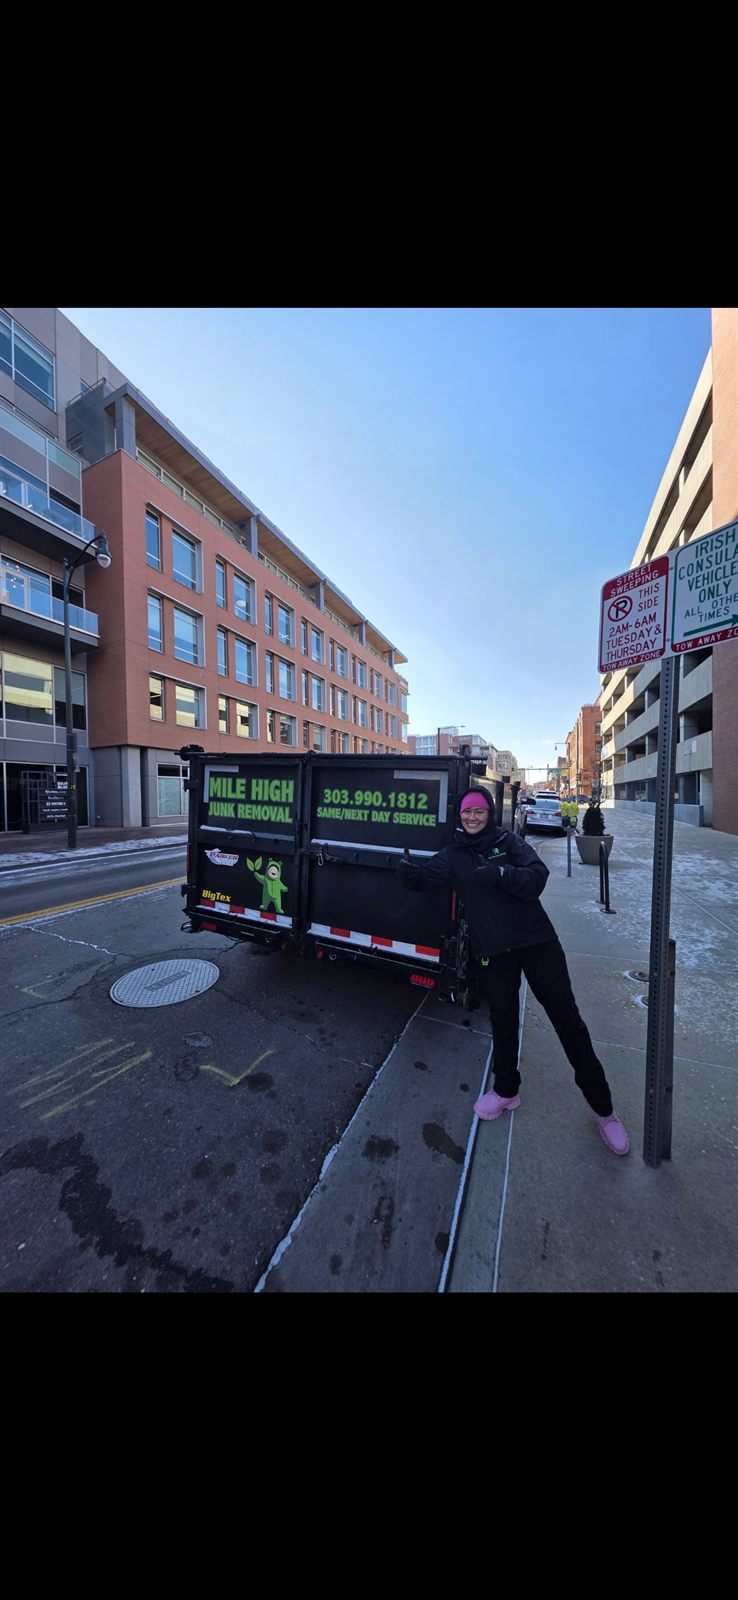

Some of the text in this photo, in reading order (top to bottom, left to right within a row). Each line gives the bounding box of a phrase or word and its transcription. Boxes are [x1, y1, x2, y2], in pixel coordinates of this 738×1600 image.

[695, 528, 736, 558] IRISH
[610, 570, 659, 597] SWEEPING
[616, 563, 652, 586] STREET
[638, 583, 660, 599] THIS
[699, 579, 732, 603] ONLY
[637, 596, 659, 612] SIDE
[684, 606, 702, 618] ALL
[698, 606, 730, 623] TIMES
[606, 624, 662, 650] TUESDAY &
[676, 640, 693, 652] TOW
[698, 632, 722, 646] AWAY
[603, 650, 661, 671] TOW AWAY ZONE
[606, 637, 657, 662] THURSDAY
[209, 777, 295, 803] MILE HIGH
[323, 788, 428, 810] 303.990.1812
[208, 801, 293, 824] JUNK REMOVAL
[316, 806, 437, 827] SAME/NEXT DAY SERVICE
[202, 889, 231, 902] BigTex
